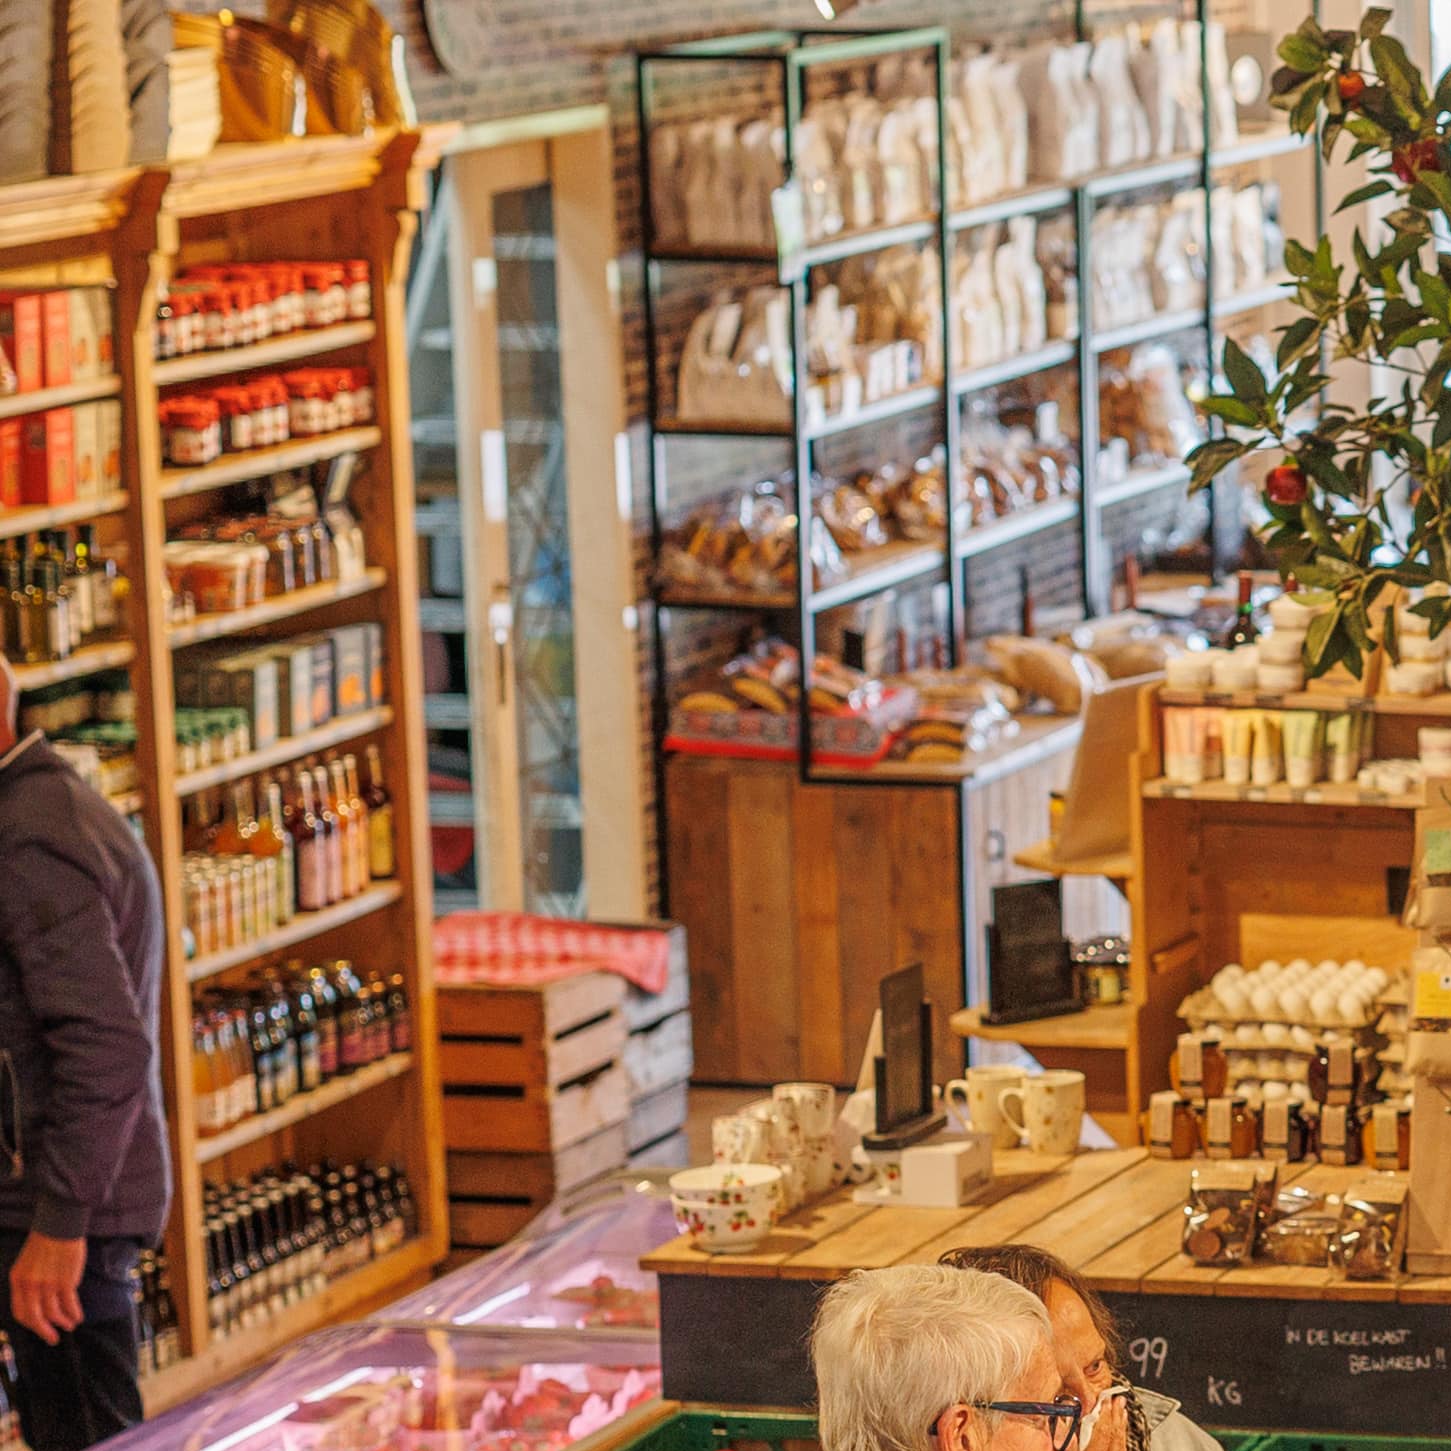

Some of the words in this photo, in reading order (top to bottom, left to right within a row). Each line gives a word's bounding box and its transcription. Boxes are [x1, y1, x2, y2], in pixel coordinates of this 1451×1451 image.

[1306, 1329, 1329, 1346] DE
[1128, 1336, 1169, 1380] 99
[1207, 1375, 1243, 1406] KG
